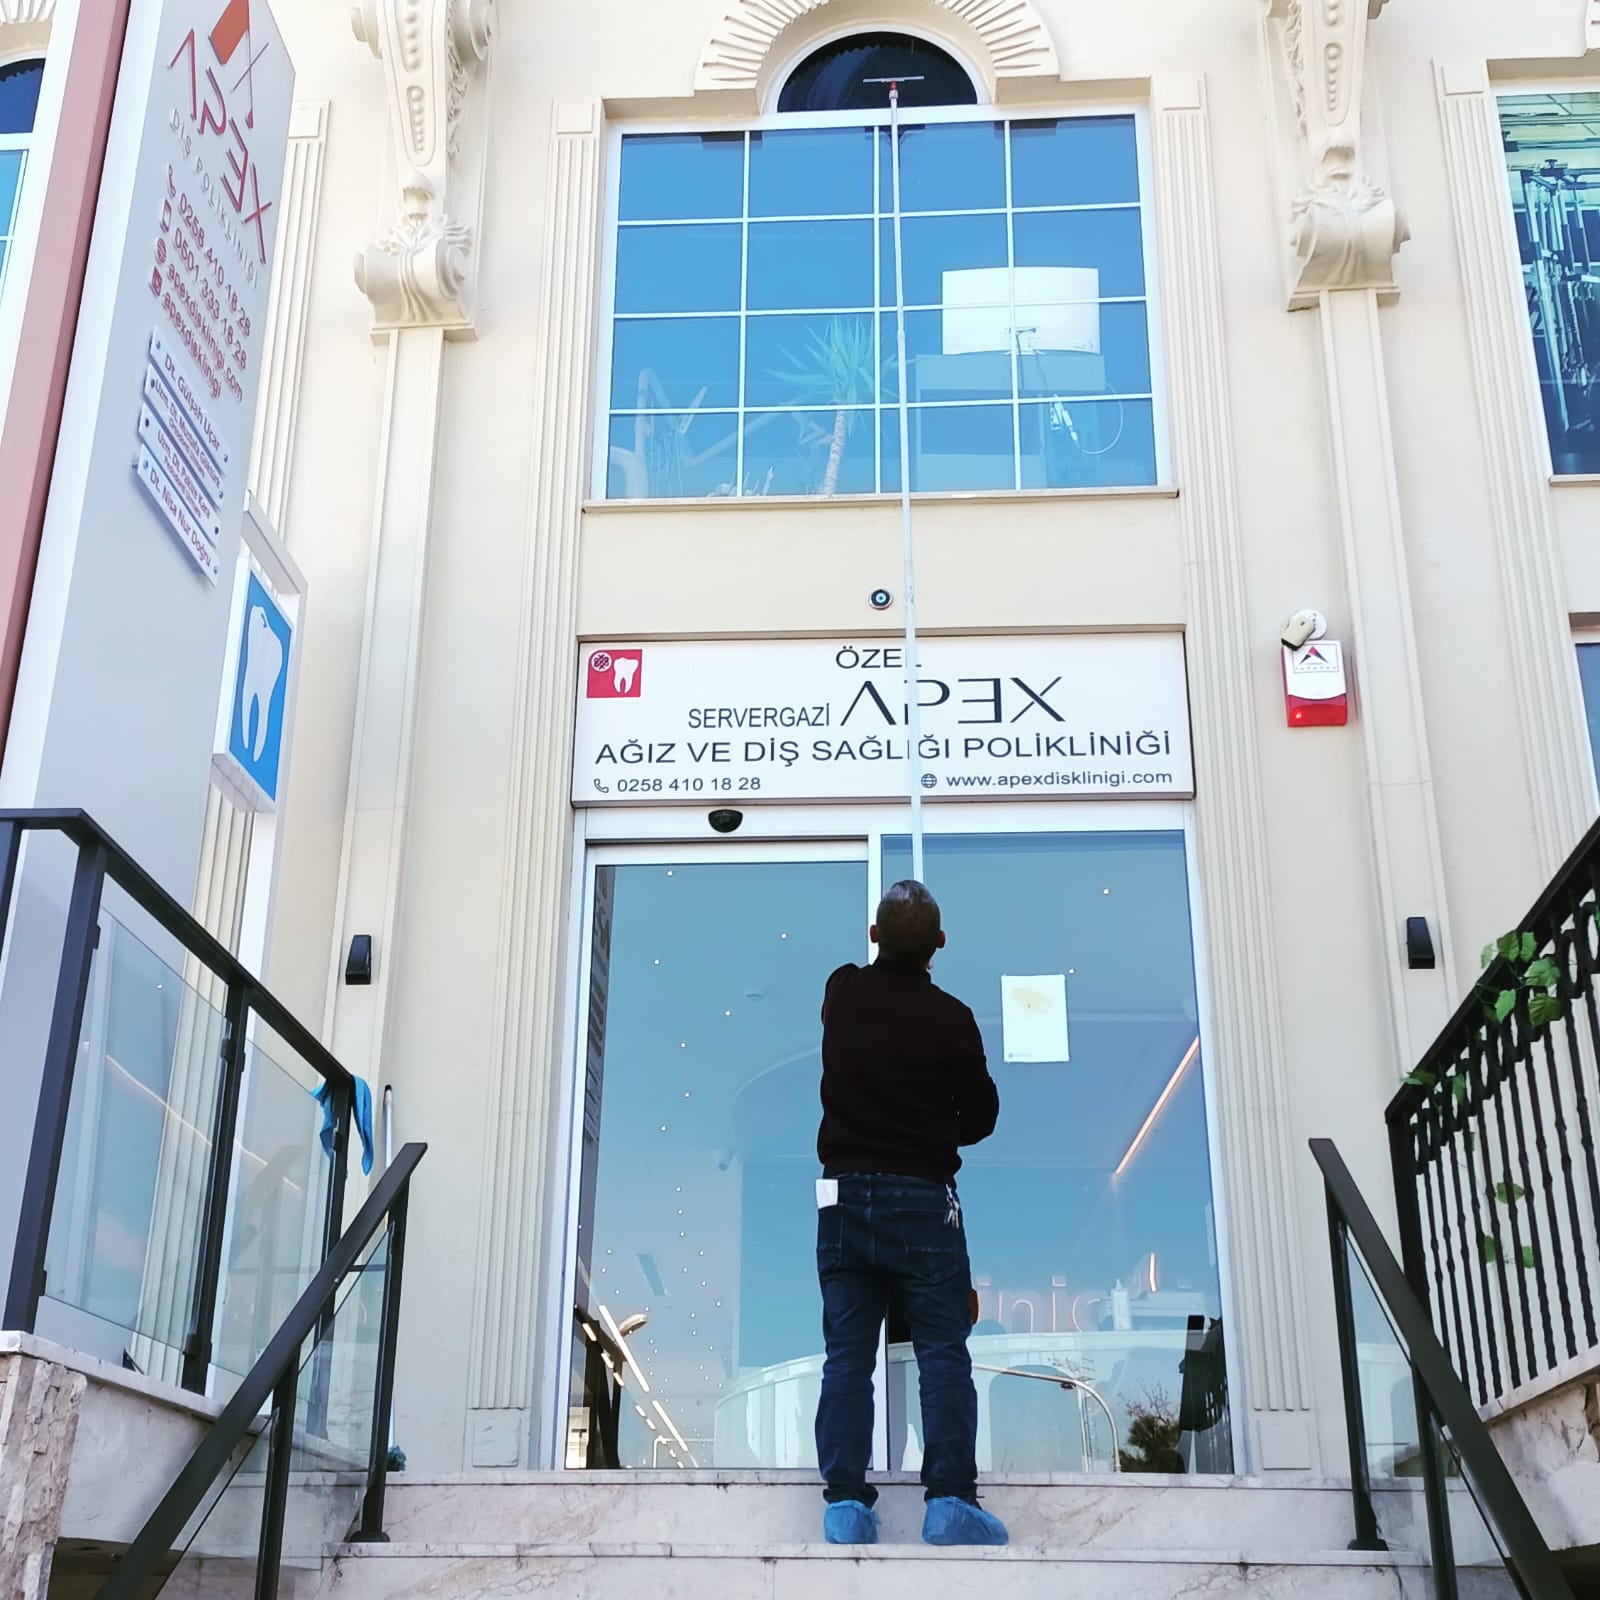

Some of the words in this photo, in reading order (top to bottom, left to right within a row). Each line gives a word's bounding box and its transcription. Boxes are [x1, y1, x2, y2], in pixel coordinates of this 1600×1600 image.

[168, 28, 272, 264] APEX
[174, 228, 199, 283] 0501
[202, 278, 220, 320] 333
[223, 318, 234, 345] 18
[235, 340, 247, 369] 28
[180, 193, 205, 248] 0258
[206, 248, 224, 286] 410
[226, 284, 238, 313] 18
[239, 307, 251, 337] 28
[163, 292, 222, 399] apexdisklinigi
[168, 264, 243, 402] apexdisklinigi.com
[178, 376, 203, 425] Gülşah
[203, 417, 220, 451] Uçar
[178, 509, 191, 536] Nur
[191, 530, 211, 567] Doğru
[595, 739, 676, 764] AĞIZ
[687, 742, 731, 763] VE
[744, 738, 799, 767] DİŞ
[964, 730, 1170, 758] POLİKLİNİĞİ
[688, 703, 830, 728] SERVERGAZİ
[617, 778, 662, 792] 0258
[669, 778, 703, 791] 410
[711, 777, 732, 791] 18
[738, 777, 761, 790] 28
[946, 770, 1172, 788] www.apexdisklinigi.com
